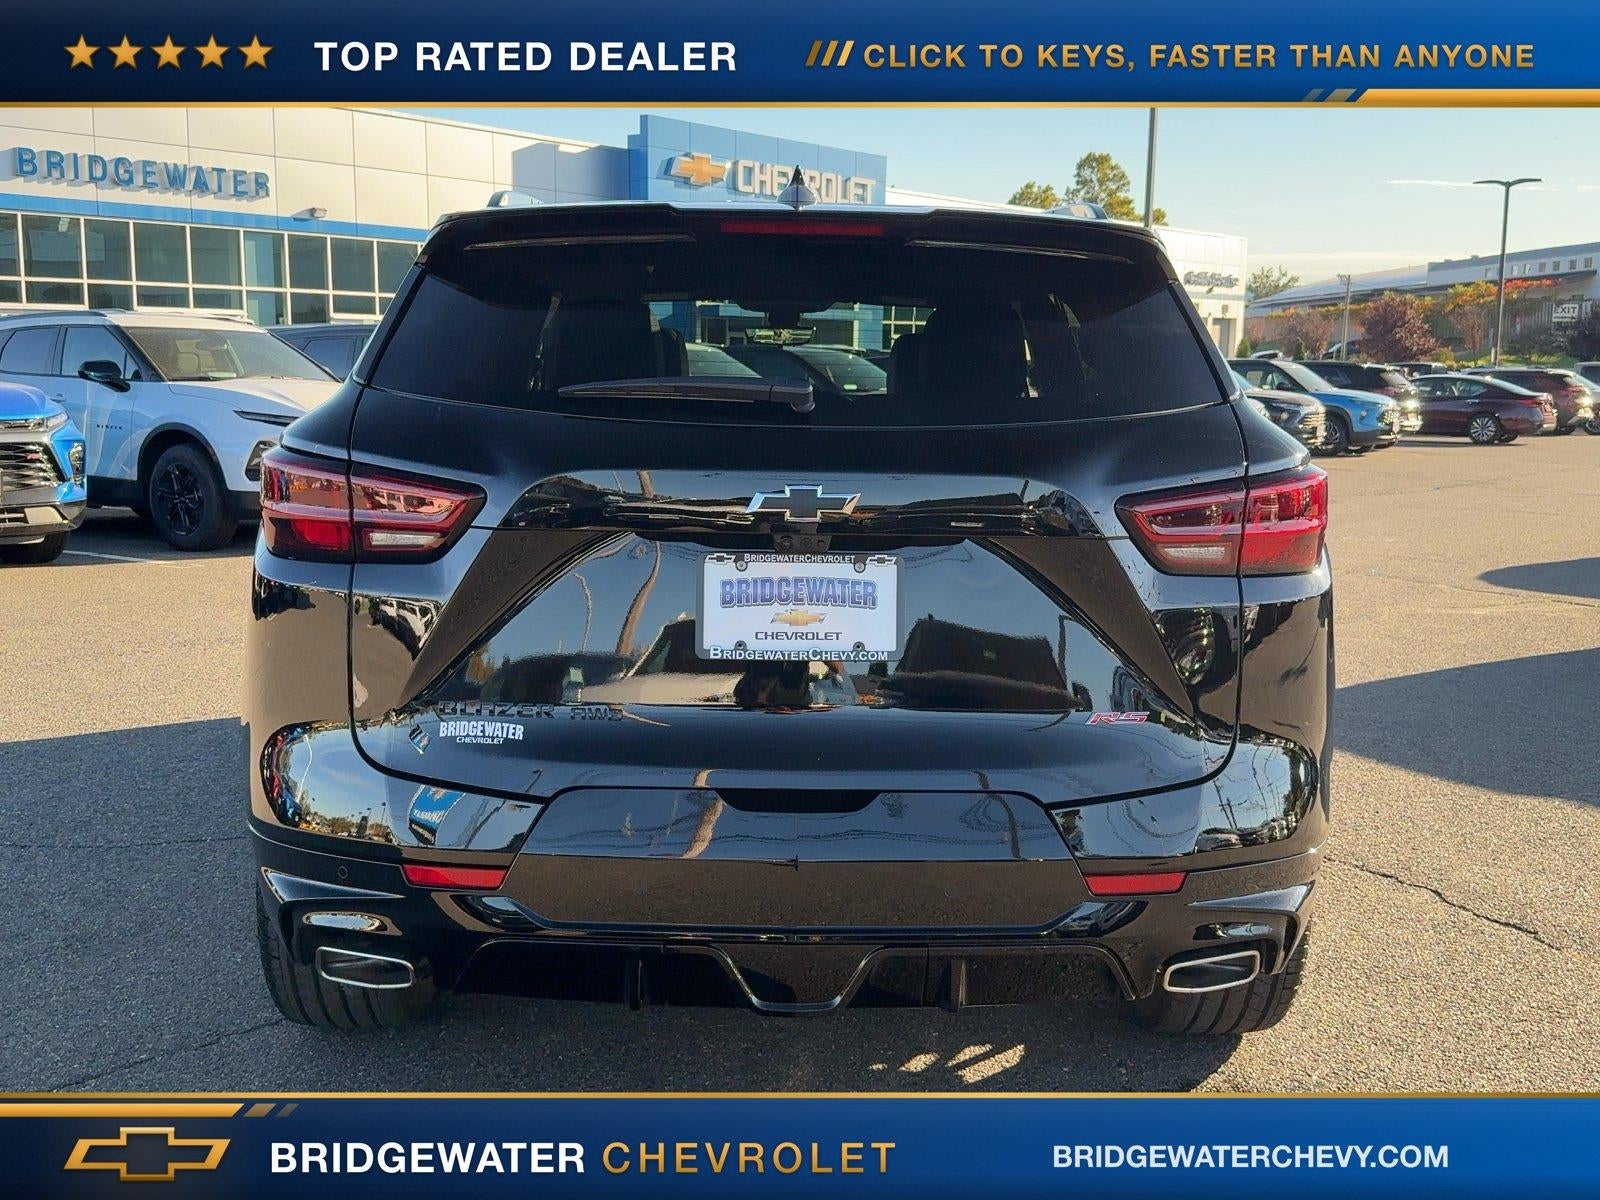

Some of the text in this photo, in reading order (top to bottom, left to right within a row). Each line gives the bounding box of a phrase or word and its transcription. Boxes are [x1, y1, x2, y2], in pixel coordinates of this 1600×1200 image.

[16, 147, 271, 198] BRIDGEWATER
[719, 576, 879, 610] BRIDGEWATER
[754, 631, 843, 641] CHEVROLET
[437, 700, 624, 722] BLAZER AWD
[1087, 711, 1150, 724] RS
[439, 721, 525, 740] BRIDGEWATER
[456, 736, 504, 745] CHEVROLET
